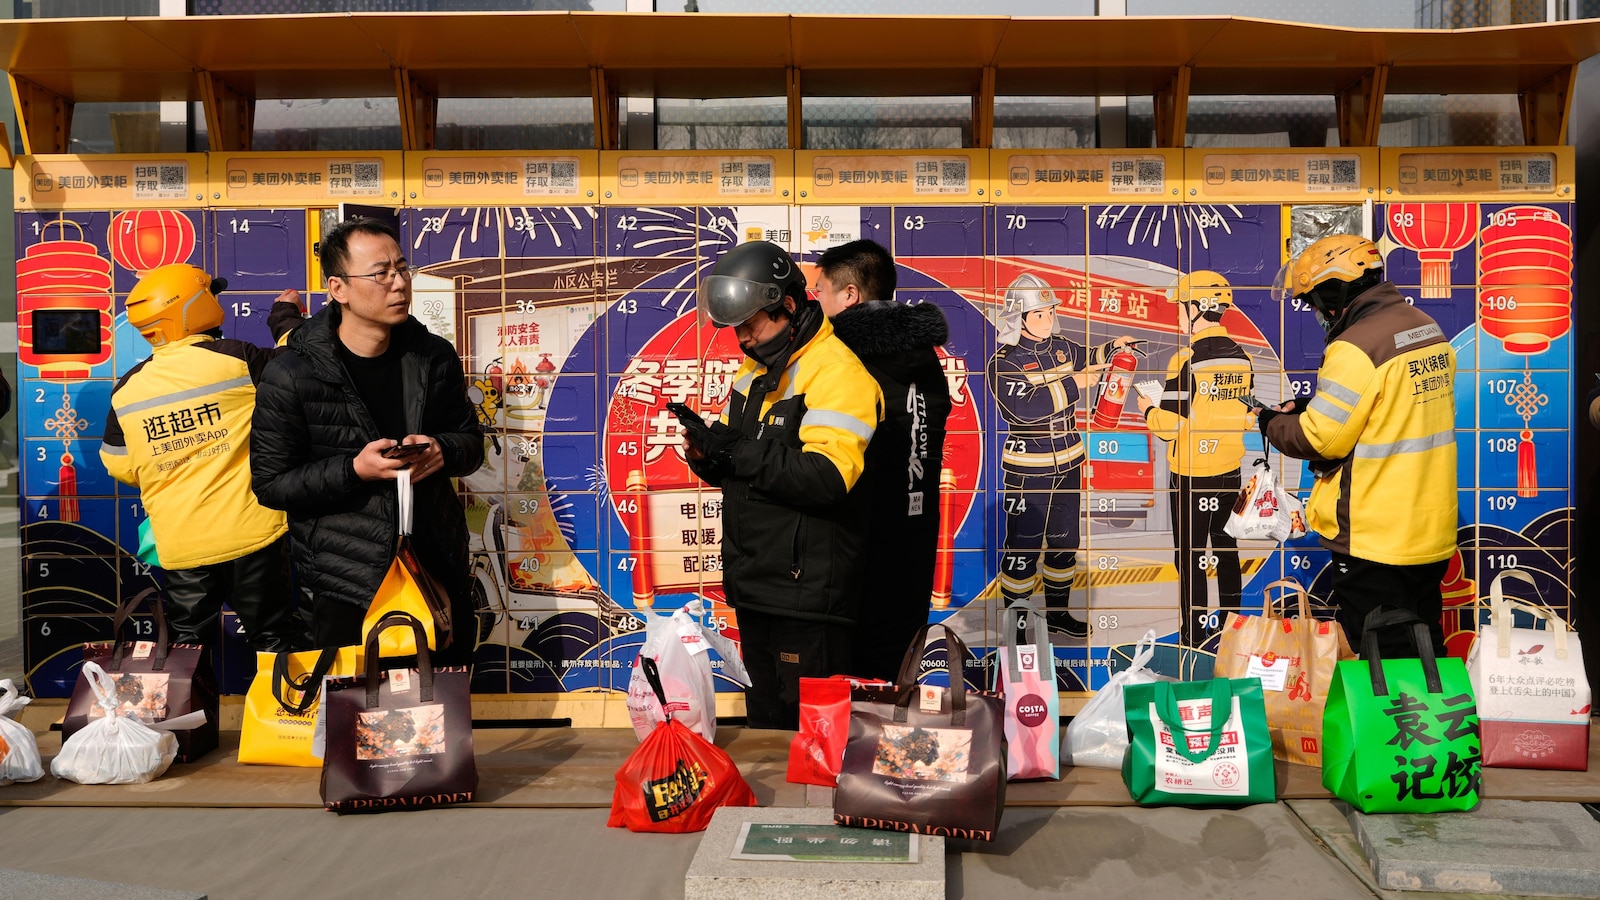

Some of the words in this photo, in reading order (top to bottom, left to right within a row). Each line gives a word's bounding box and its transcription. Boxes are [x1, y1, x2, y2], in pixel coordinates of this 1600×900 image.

[136, 167, 158, 178] 扫码
[329, 164, 352, 175] 扫码
[526, 163, 548, 174] 扫码
[721, 162, 743, 173] 扫码
[915, 161, 938, 173] 扫码
[1111, 161, 1134, 172] 扫码
[1307, 160, 1330, 171] 扫码
[1500, 160, 1522, 171] 扫码
[58, 176, 127, 188] 美团外卖柜
[252, 172, 321, 186] 美团外卖柜
[329, 177, 352, 188] 存取
[449, 171, 518, 184] 美团外卖柜
[526, 176, 548, 188] 存取
[644, 171, 713, 184] 美团外卖柜
[721, 176, 743, 187] 存取
[838, 170, 908, 184] 美团外卖柜
[915, 175, 938, 186] 存取
[1034, 169, 1104, 183] 美团外卖柜
[1111, 174, 1134, 186] 存取
[1230, 168, 1299, 182] 美团外卖柜
[1307, 173, 1330, 185] 存取
[1423, 168, 1493, 182] 美团外卖柜
[1500, 174, 1523, 185] 存取
[136, 180, 158, 191] 存取
[514, 216, 535, 231] 35
[616, 215, 638, 231] 42
[707, 216, 728, 231] 49
[811, 216, 832, 231] 56
[903, 215, 925, 230] 63
[1005, 214, 1027, 230] 70
[1098, 214, 1119, 229] 77
[1199, 213, 1219, 228] 84
[1393, 212, 1414, 227] 98
[1487, 212, 1517, 227] 105
[1533, 211, 1553, 222] 广告
[31, 221, 40, 236] 1
[124, 220, 134, 235] 7
[230, 219, 250, 234] 14
[422, 217, 442, 232] 28
[765, 229, 792, 243] 美团
[553, 269, 618, 290] 小区公告栏
[617, 300, 638, 314] 43
[1006, 298, 1025, 313] 71
[1068, 280, 1150, 319] 消防站
[1098, 298, 1119, 313] 78
[1199, 297, 1219, 312] 85
[1487, 296, 1517, 310] 106
[231, 302, 251, 318] 15
[422, 300, 444, 316] 29
[515, 300, 536, 315] 36
[497, 322, 540, 336] 消防安全
[1408, 327, 1438, 341] MEITUAN
[497, 334, 540, 347] 人人有责
[517, 383, 537, 397] 37
[617, 383, 638, 397] 44
[708, 383, 726, 398] 51
[1006, 381, 1027, 396] 72
[1098, 381, 1119, 396] 79
[1199, 381, 1219, 396] 86
[1291, 381, 1312, 395] 93
[1487, 380, 1517, 394] 107
[35, 388, 45, 403] 2
[142, 401, 222, 443] 逛超市
[915, 393, 928, 459] 777-LOVE
[151, 428, 229, 457] 上美团外卖App
[518, 441, 538, 456] 38
[617, 441, 638, 456] 45
[1006, 440, 1027, 455] 73
[1098, 440, 1119, 455] 80
[1198, 440, 1219, 454] 87
[1487, 438, 1517, 453] 108
[37, 447, 47, 462] 3
[519, 500, 539, 514] 39
[617, 500, 638, 514] 46
[1006, 498, 1027, 513] 74
[1098, 498, 1117, 513] 81
[1198, 497, 1219, 512] 88
[1487, 496, 1517, 511] 109
[38, 504, 49, 519] 4
[681, 527, 722, 546] 取暖
[519, 558, 540, 573] 40
[617, 557, 638, 572] 47
[1006, 556, 1027, 571] 75
[1098, 556, 1119, 570] 82
[1198, 555, 1219, 570] 89
[1291, 555, 1311, 570] 96
[1487, 554, 1518, 569] 110
[39, 563, 50, 578] 5
[132, 562, 152, 577] 12
[133, 620, 153, 635] 13
[520, 617, 539, 631] 41
[617, 617, 638, 631] 48
[708, 617, 728, 631] 55
[1098, 615, 1119, 629] 83
[1198, 614, 1219, 629] 90
[41, 622, 51, 637] 6
[1489, 674, 1576, 688] 6年大众点评必吃榜
[1489, 685, 1577, 699] 登上《舌尖上的中国》
